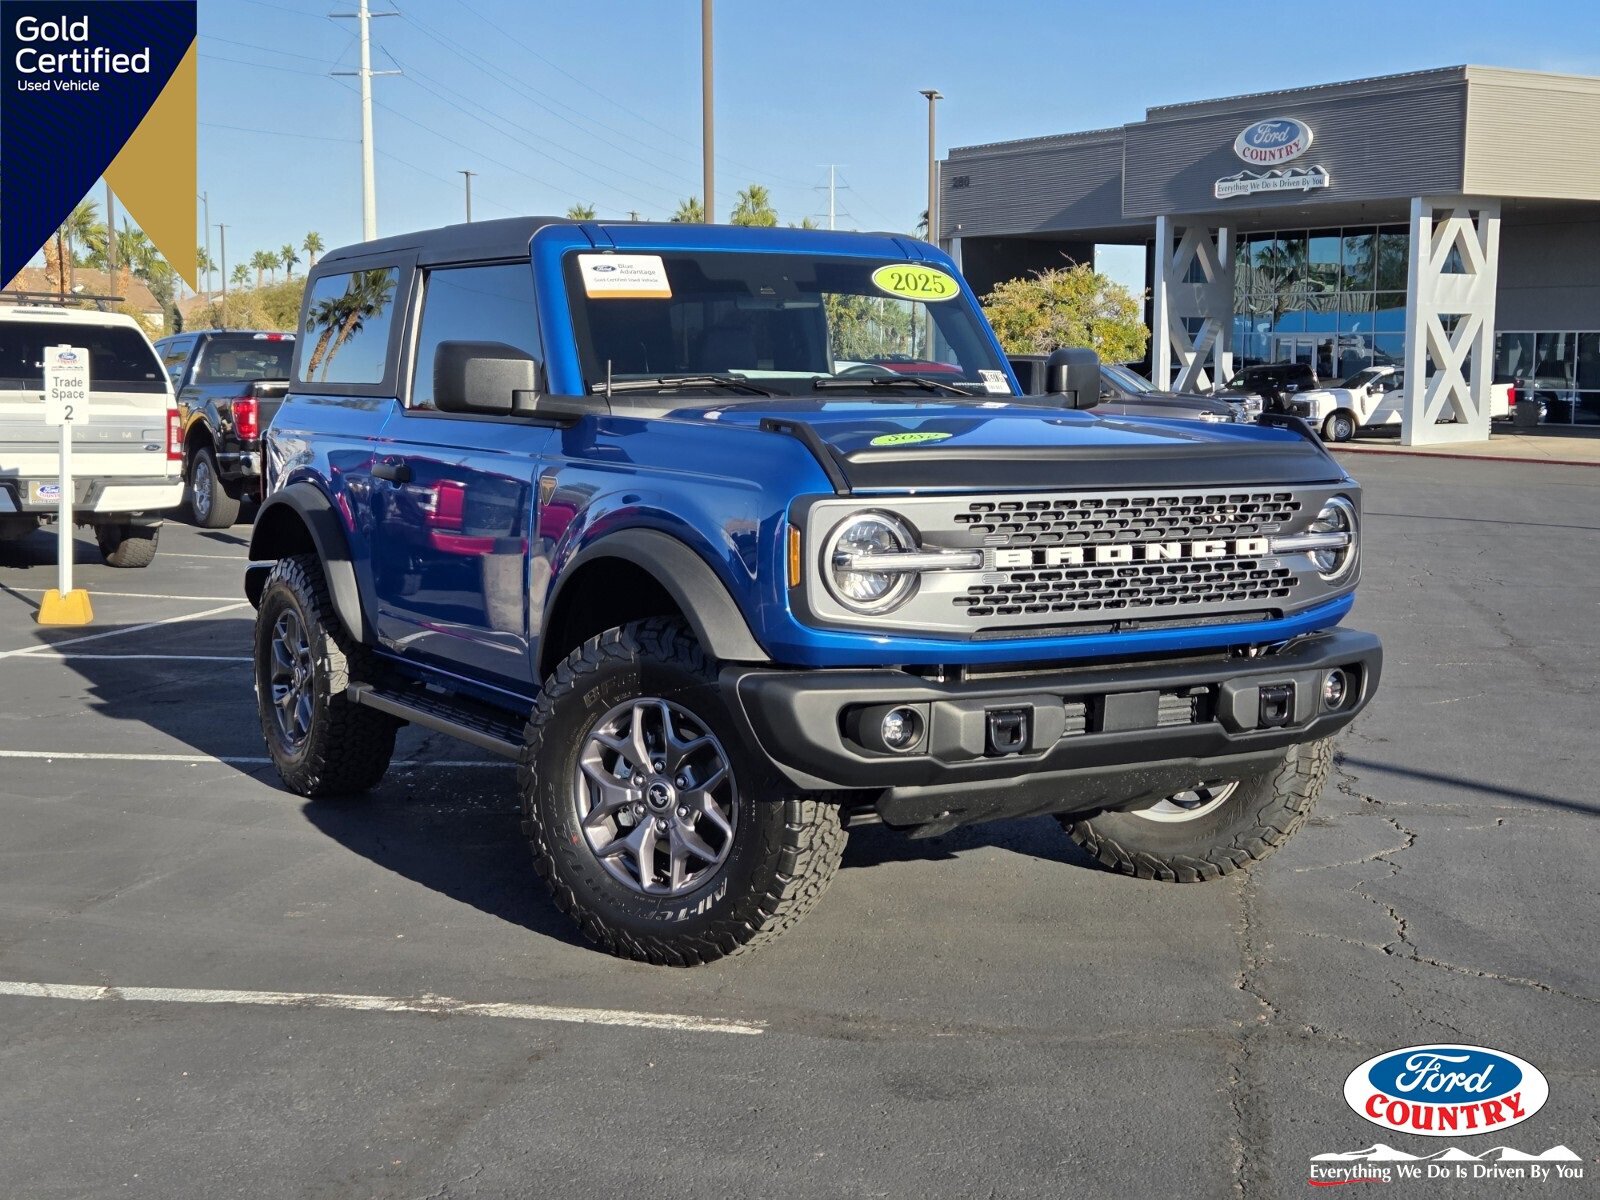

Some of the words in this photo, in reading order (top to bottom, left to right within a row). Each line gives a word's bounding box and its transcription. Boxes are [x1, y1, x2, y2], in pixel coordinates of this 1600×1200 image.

[1253, 123, 1290, 144] Ford
[1242, 139, 1301, 161] COUNTRY
[1217, 182, 1249, 193] Everything
[1250, 181, 1260, 189] We
[1262, 180, 1271, 188] Do
[1279, 178, 1300, 187] Driven
[1302, 177, 1310, 188] By
[1312, 177, 1324, 185] You
[890, 272, 946, 294] 2025
[53, 376, 83, 387] Trade
[51, 388, 85, 401] Space
[64, 405, 74, 420] 2
[995, 537, 1269, 569] BRONCO
